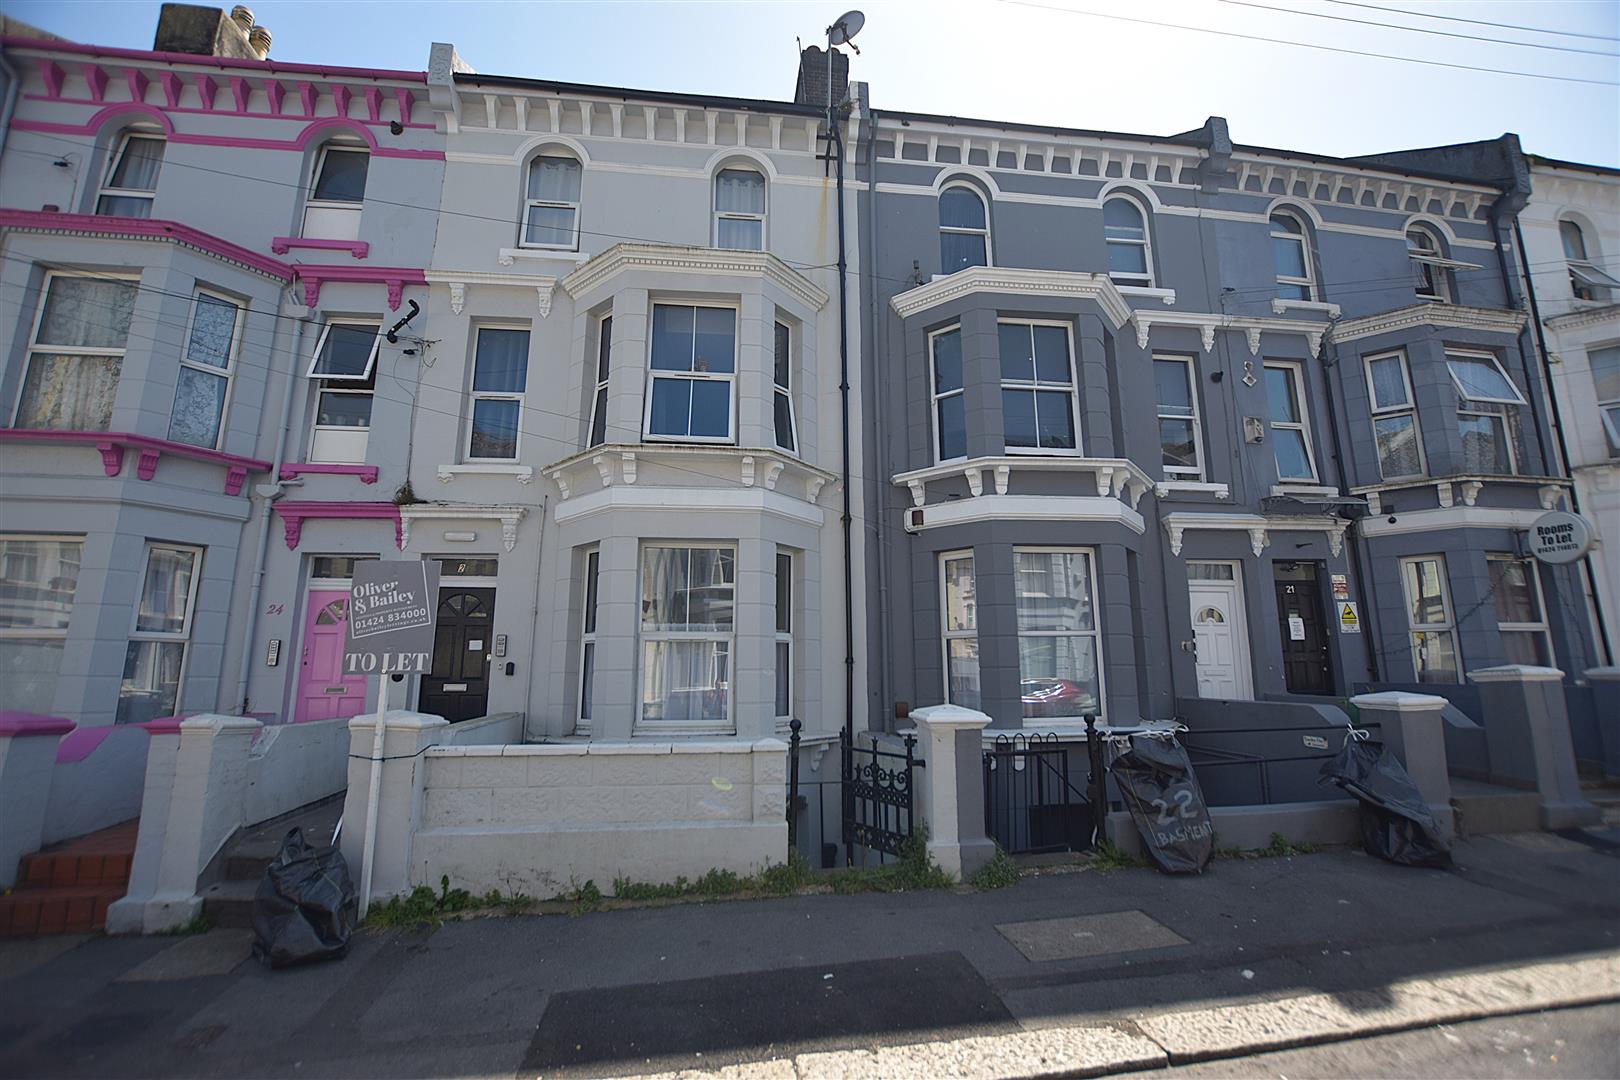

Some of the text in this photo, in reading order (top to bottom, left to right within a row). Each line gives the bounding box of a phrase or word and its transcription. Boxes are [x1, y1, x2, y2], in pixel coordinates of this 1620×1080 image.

[1537, 523, 1574, 536] Rooms
[1541, 533, 1573, 546] To Let
[353, 581, 399, 598] Oliver
[1285, 585, 1296, 594] 21
[266, 604, 284, 616] 24
[354, 599, 367, 614] &
[370, 590, 416, 608] Bailey
[355, 615, 385, 629] 01424
[387, 607, 426, 622] 834000
[346, 652, 429, 672] TO LET
[1151, 789, 1198, 826] 22
